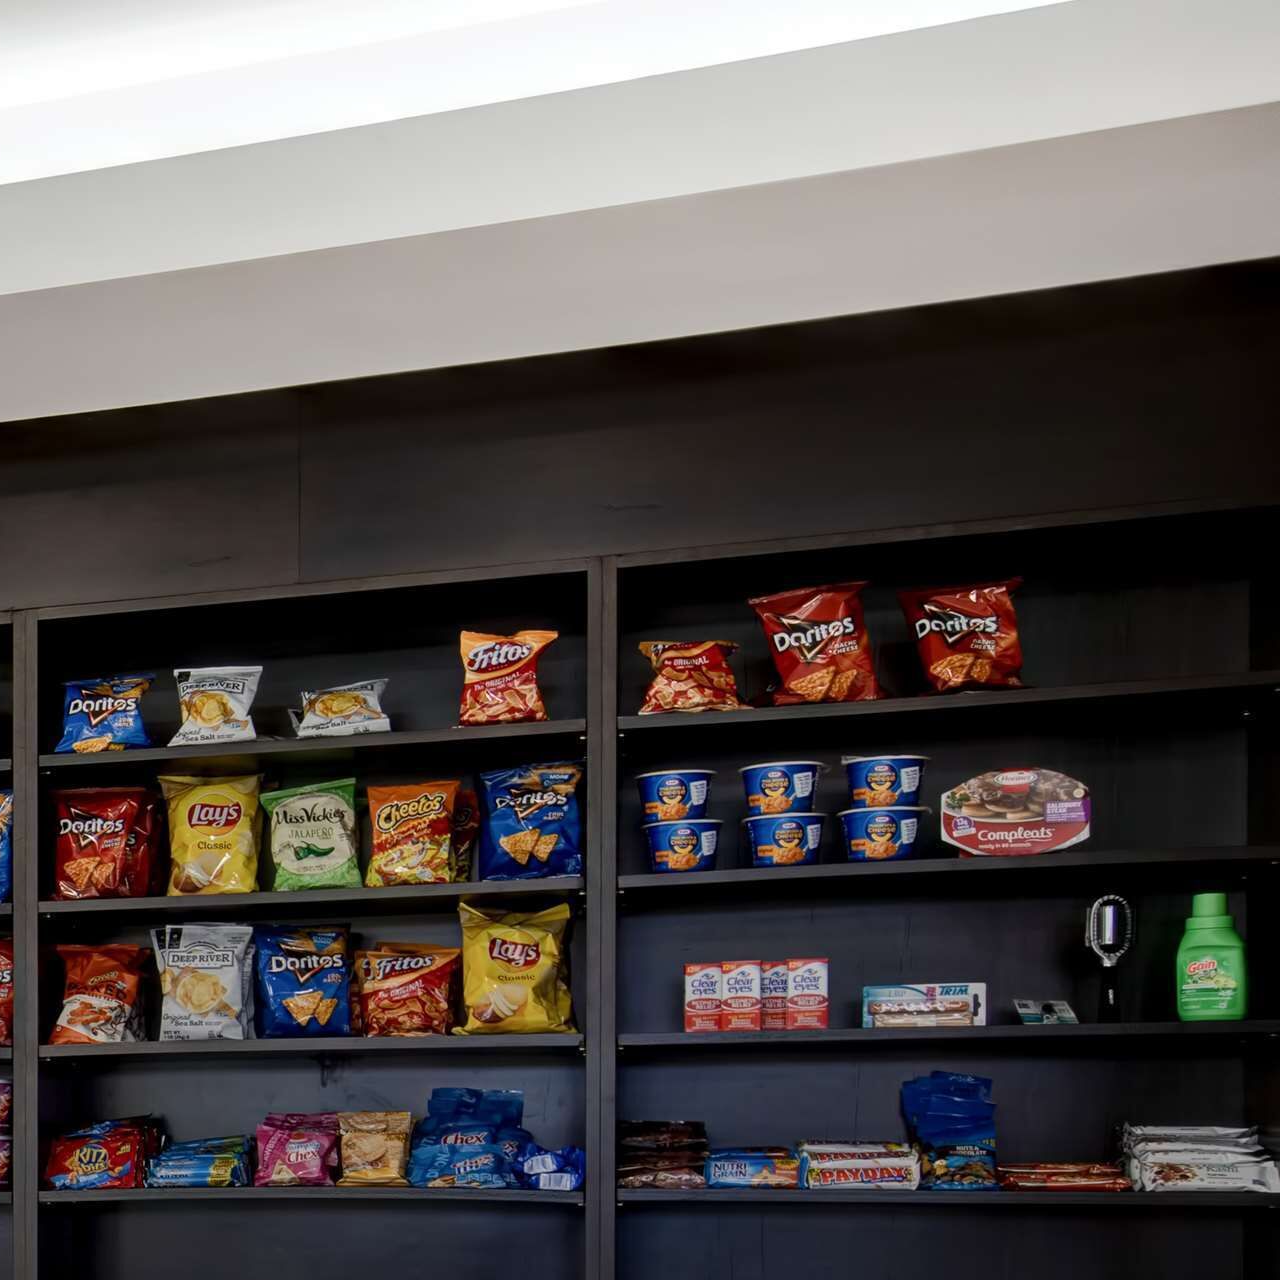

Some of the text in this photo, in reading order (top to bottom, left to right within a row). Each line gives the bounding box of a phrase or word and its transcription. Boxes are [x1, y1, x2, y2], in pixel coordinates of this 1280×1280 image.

[774, 617, 854, 652] Doritos
[916, 616, 998, 638] Doritos
[468, 641, 532, 670] Fritos
[69, 697, 137, 715] Doritos
[191, 804, 239, 827] Lay's
[376, 793, 447, 832] Cheetos
[60, 818, 124, 834] Doritos
[978, 827, 1052, 843] Compleats
[197, 840, 232, 850] Classic
[171, 953, 230, 963] DEEP RIVER
[271, 954, 344, 972] Doritos
[375, 956, 432, 980] Fritos
[1187, 960, 1217, 975] Gain
[691, 979, 718, 988] Clear
[727, 977, 754, 986] Clear
[793, 974, 821, 984] Clear
[692, 988, 716, 996] eyes
[728, 986, 752, 994] eyes
[794, 984, 819, 992] eyes
[940, 985, 969, 996] TRIM
[441, 1132, 488, 1145] Chex
[288, 1151, 321, 1162] Chex
[821, 1168, 905, 1183] PAYDAY
